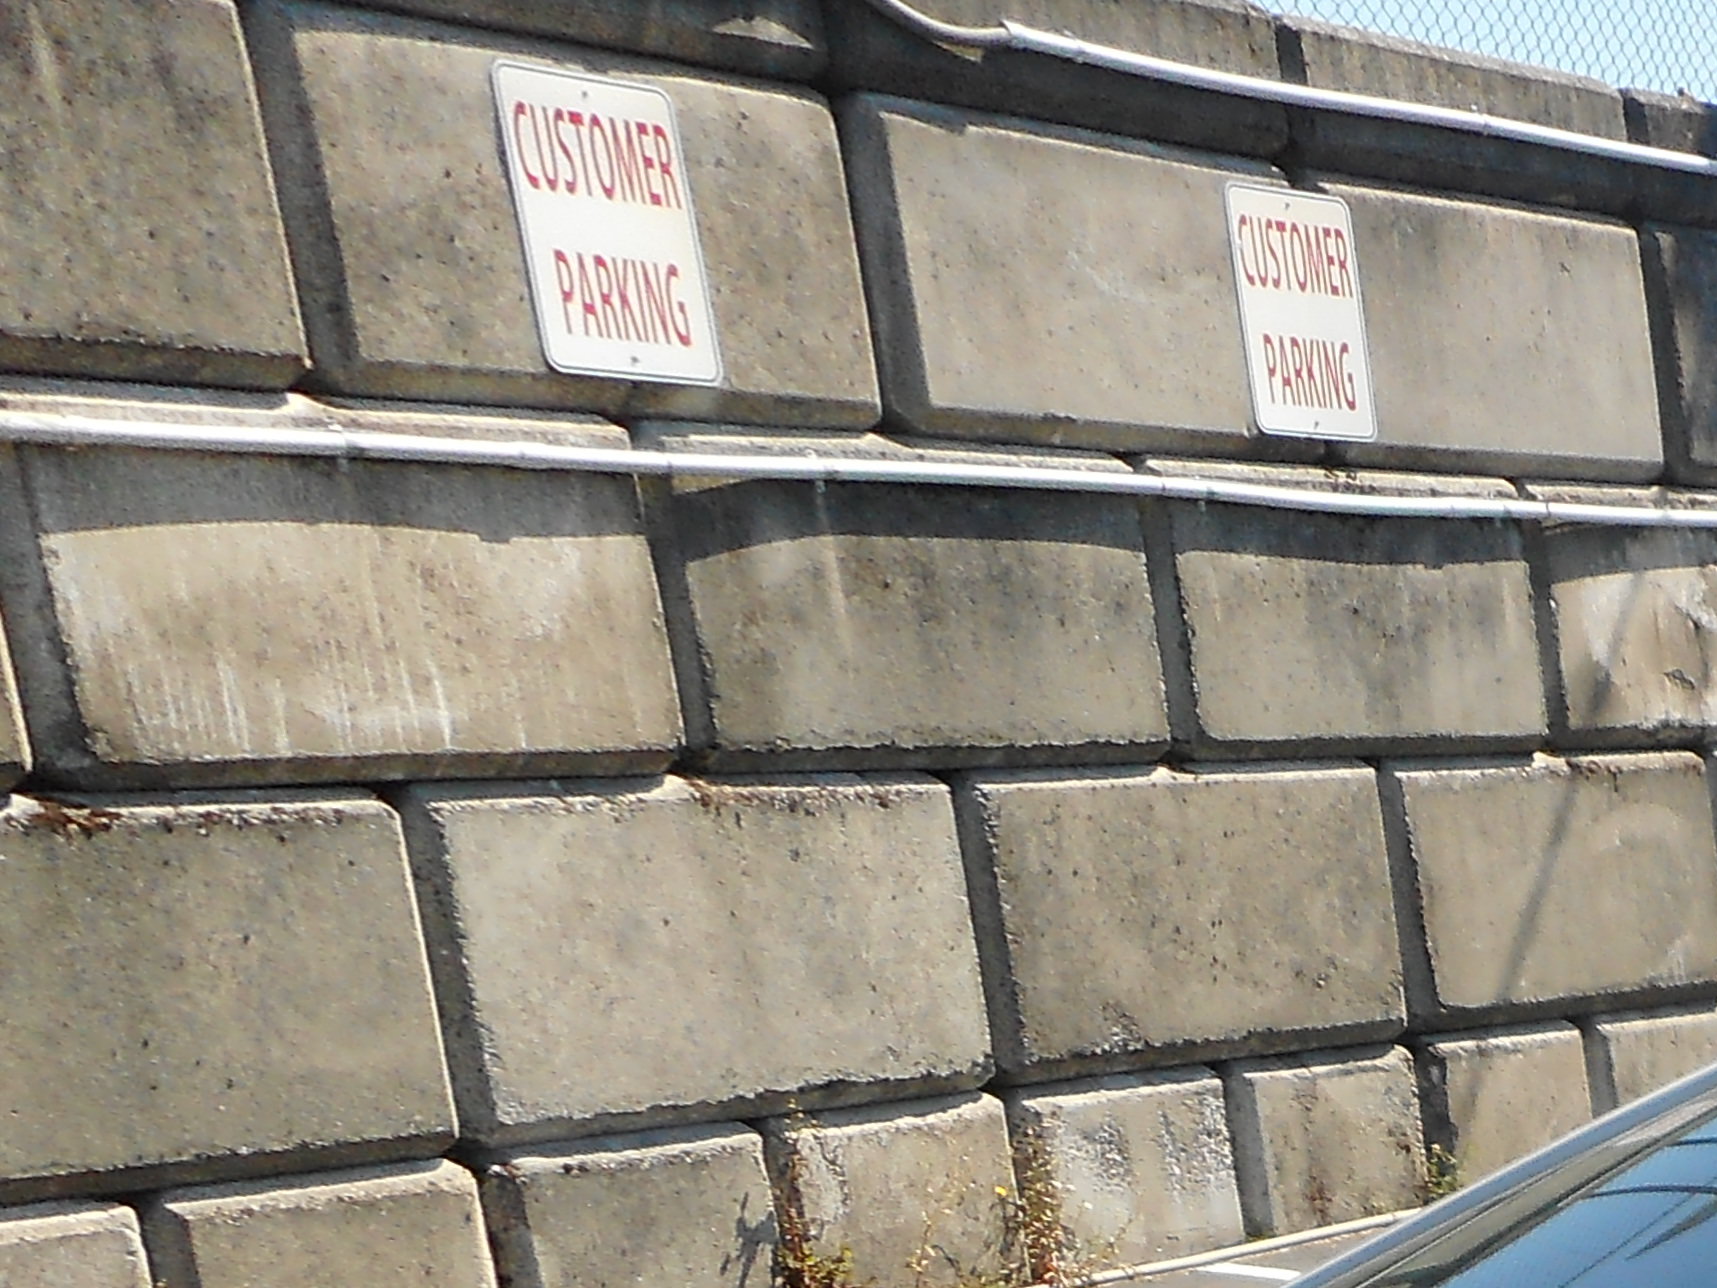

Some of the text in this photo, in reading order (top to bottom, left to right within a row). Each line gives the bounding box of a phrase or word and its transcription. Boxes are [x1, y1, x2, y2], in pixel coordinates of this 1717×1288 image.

[513, 101, 682, 210] CUSTOMER
[553, 248, 693, 348] PARKING
[1238, 214, 1352, 298] CUSTOMER
[1264, 332, 1358, 412] PARKING
